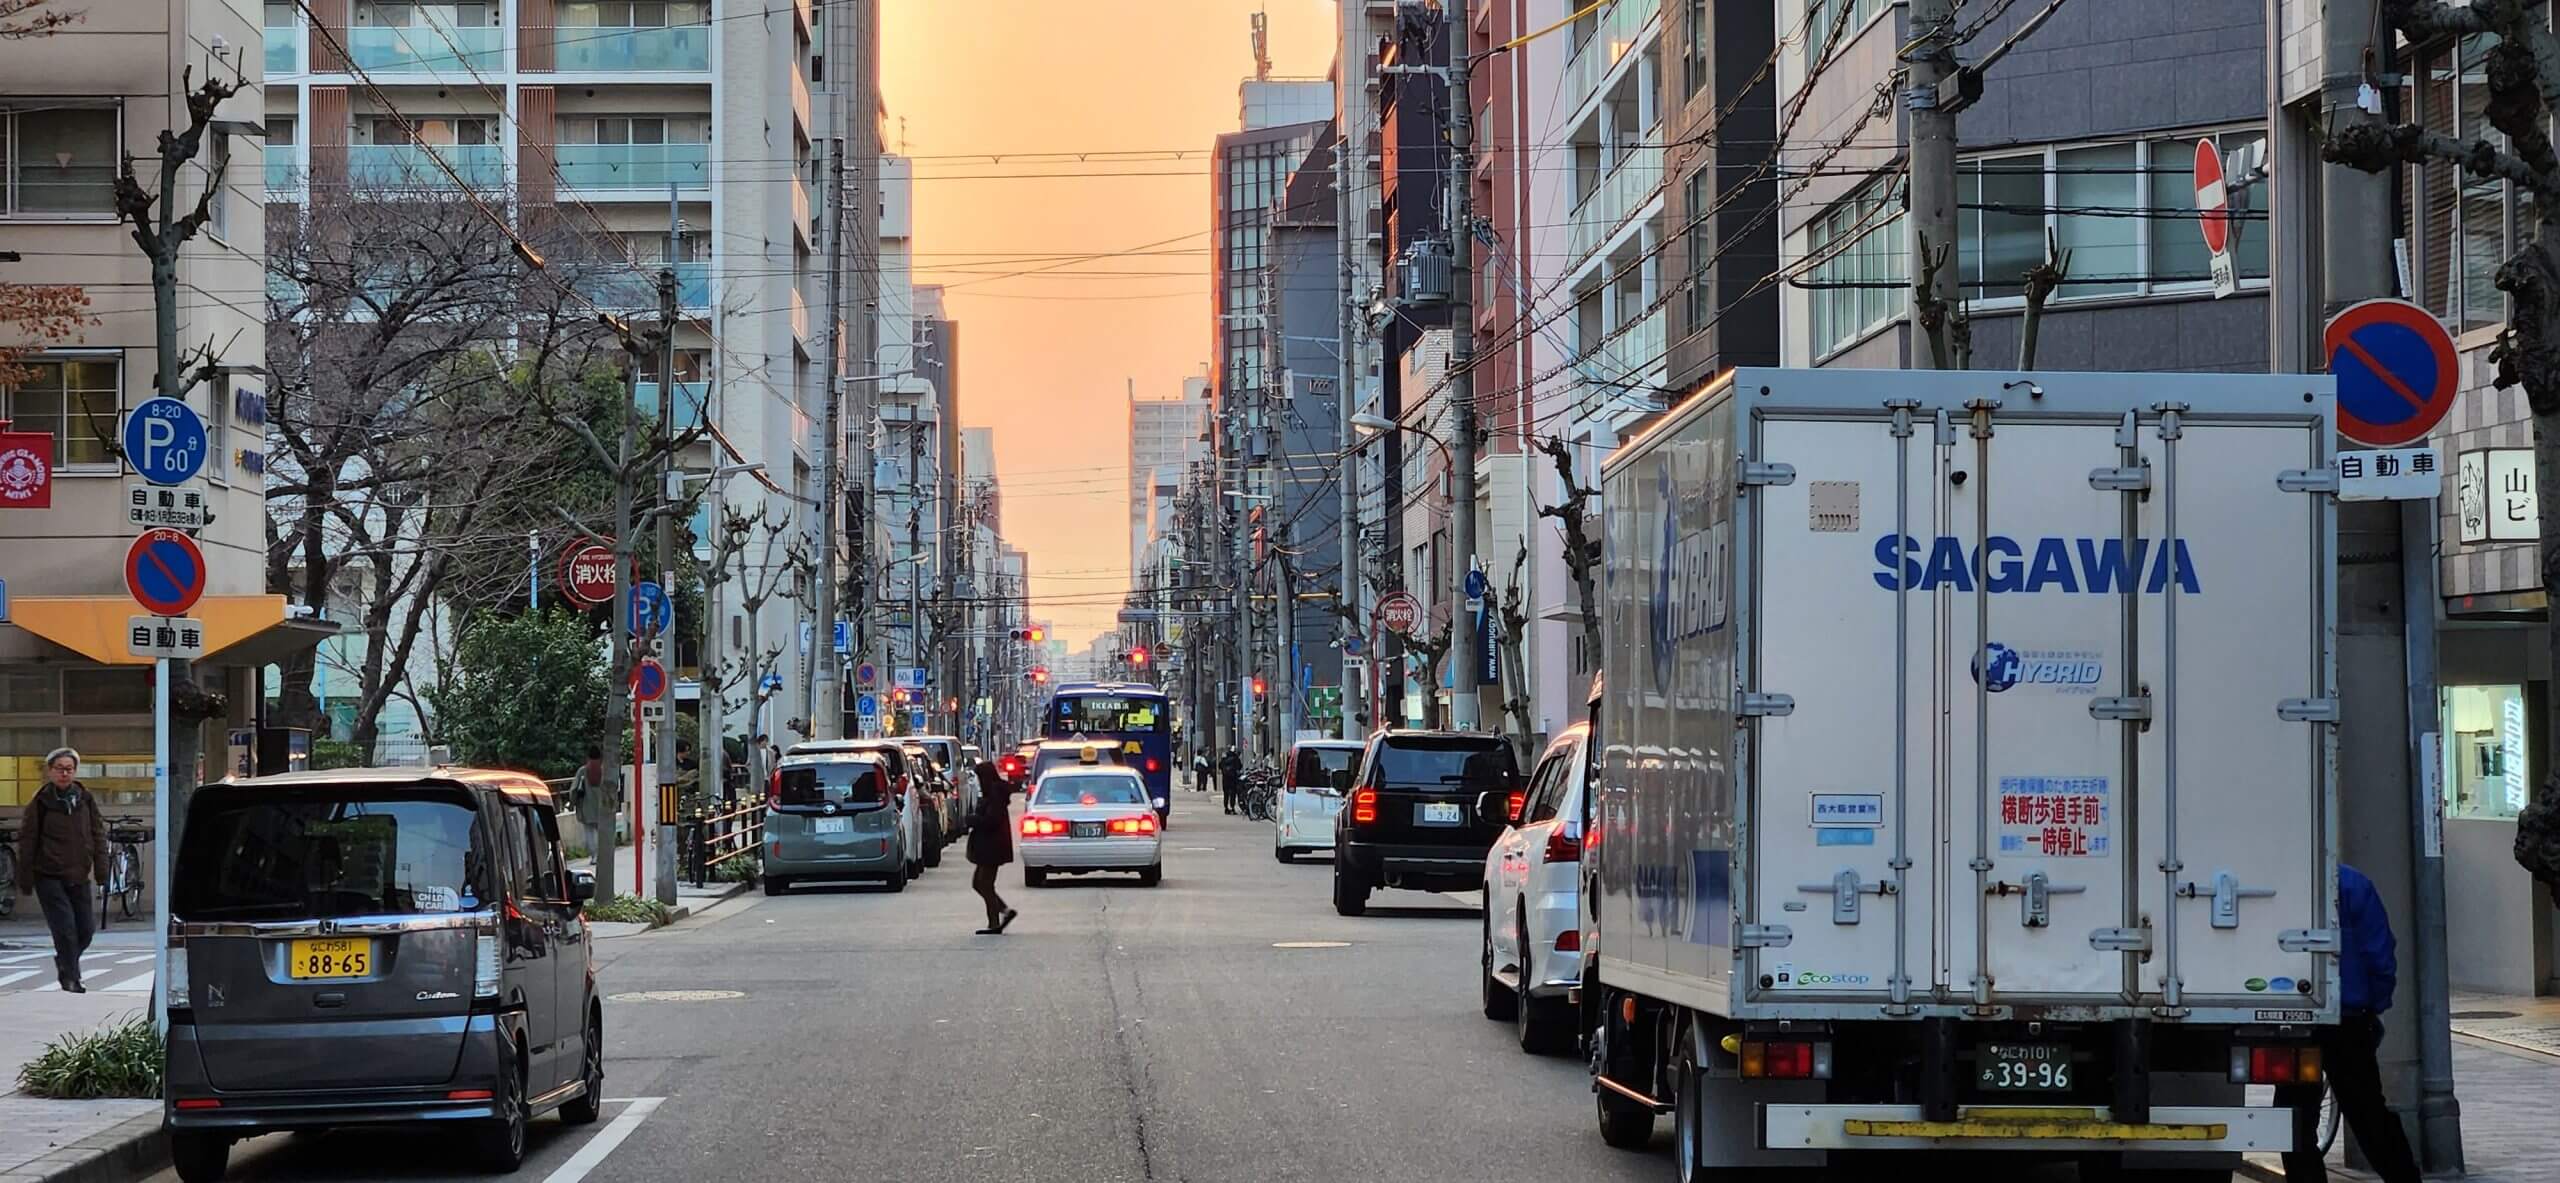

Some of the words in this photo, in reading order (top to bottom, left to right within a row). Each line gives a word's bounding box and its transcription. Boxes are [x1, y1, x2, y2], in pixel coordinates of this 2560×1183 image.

[151, 404, 181, 418] 8-20
[144, 417, 175, 470] P
[2341, 452, 2435, 479] 自動車
[132, 489, 200, 509] 自動車
[153, 531, 180, 542] 20-8
[575, 563, 616, 585] 消火栓
[1873, 534, 2201, 594] SAGAWA
[1667, 520, 1730, 643] HYBRID
[132, 626, 200, 649] 自動車
[2002, 661, 2102, 684] HYBRID
[309, 953, 365, 974] 88-65
[1797, 972, 1869, 985] ecostop
[2000, 1046, 2050, 1059] なにわ101
[1998, 1062, 2067, 1088] 39-96
